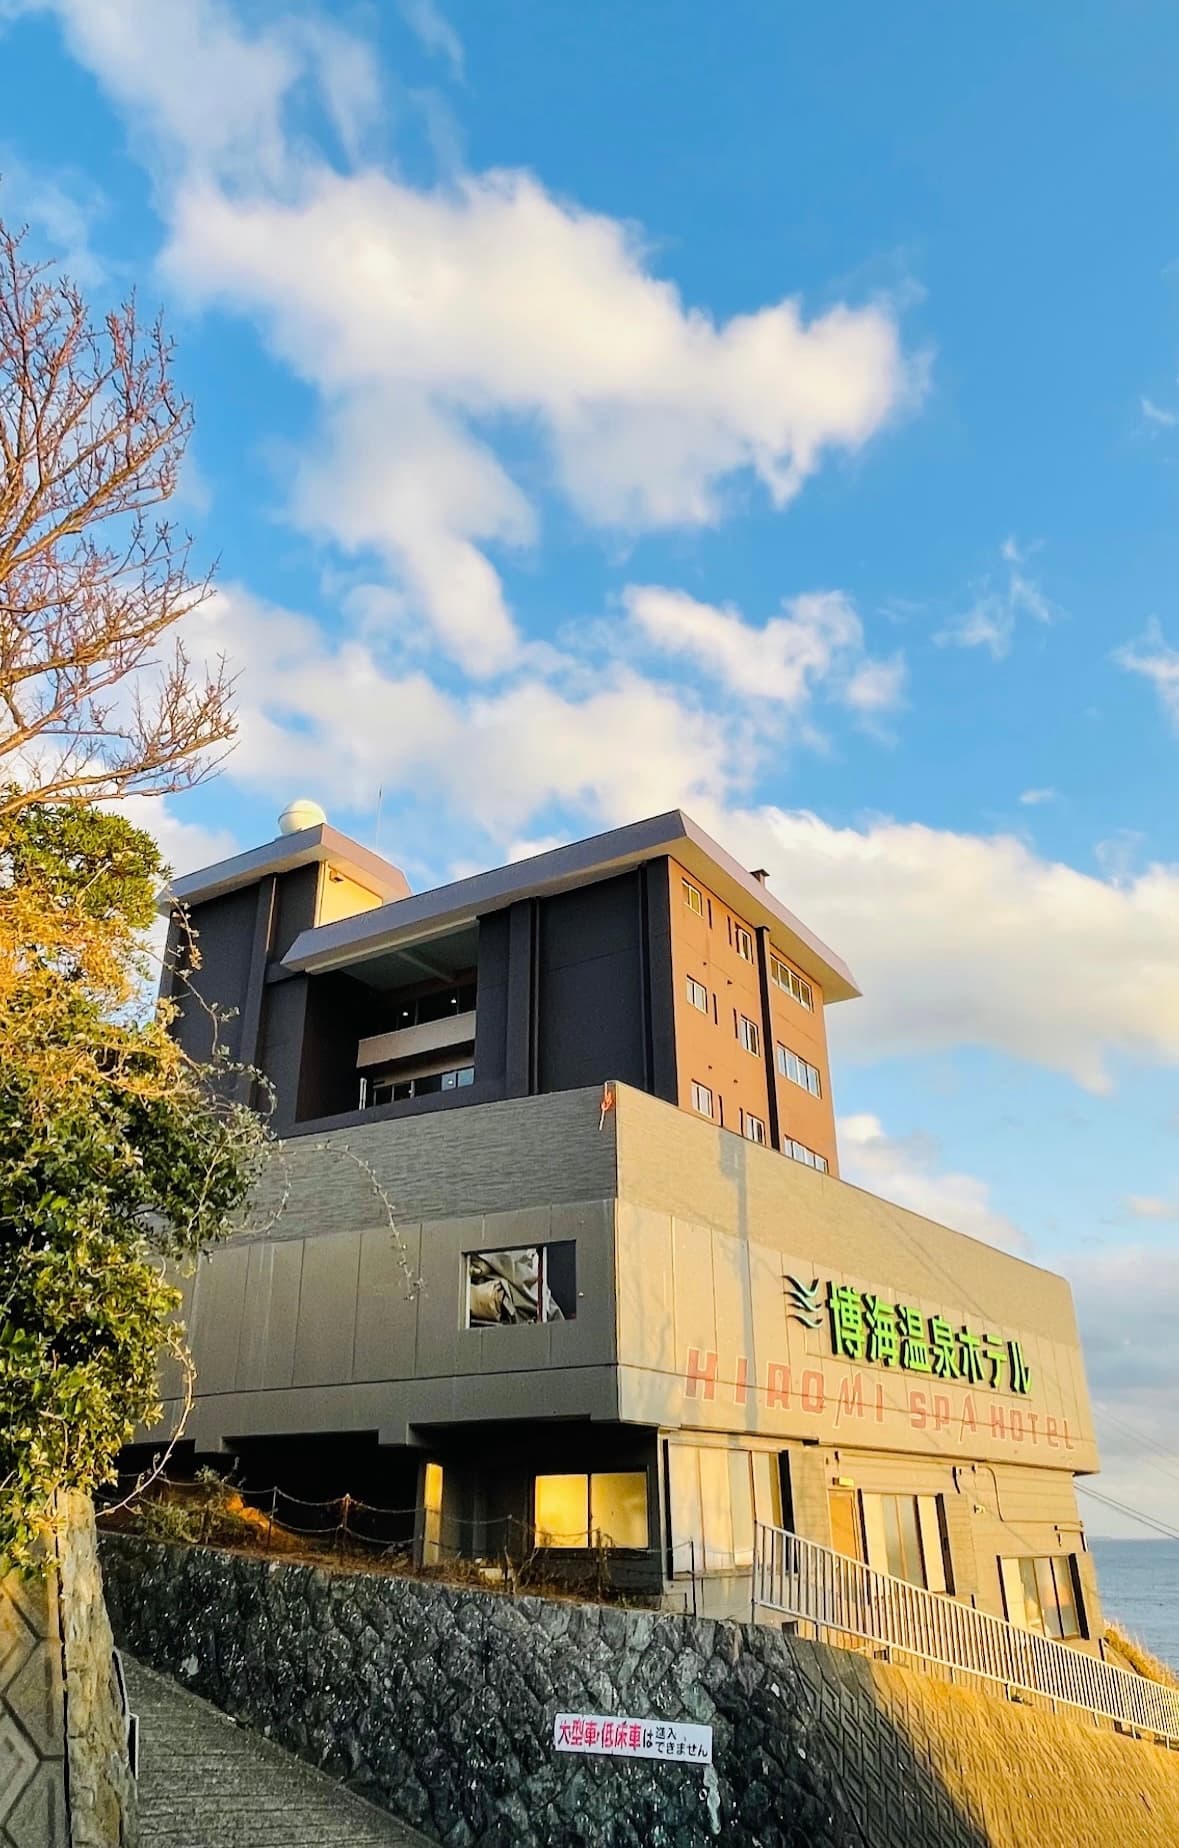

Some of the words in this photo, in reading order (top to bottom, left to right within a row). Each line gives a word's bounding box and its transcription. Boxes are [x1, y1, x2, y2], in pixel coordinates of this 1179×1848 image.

[826, 1280, 1033, 1395] 博海温泉ホテル
[684, 1347, 885, 1428] HIROMI
[909, 1390, 978, 1443] SPA
[655, 1741, 708, 1758] できません
